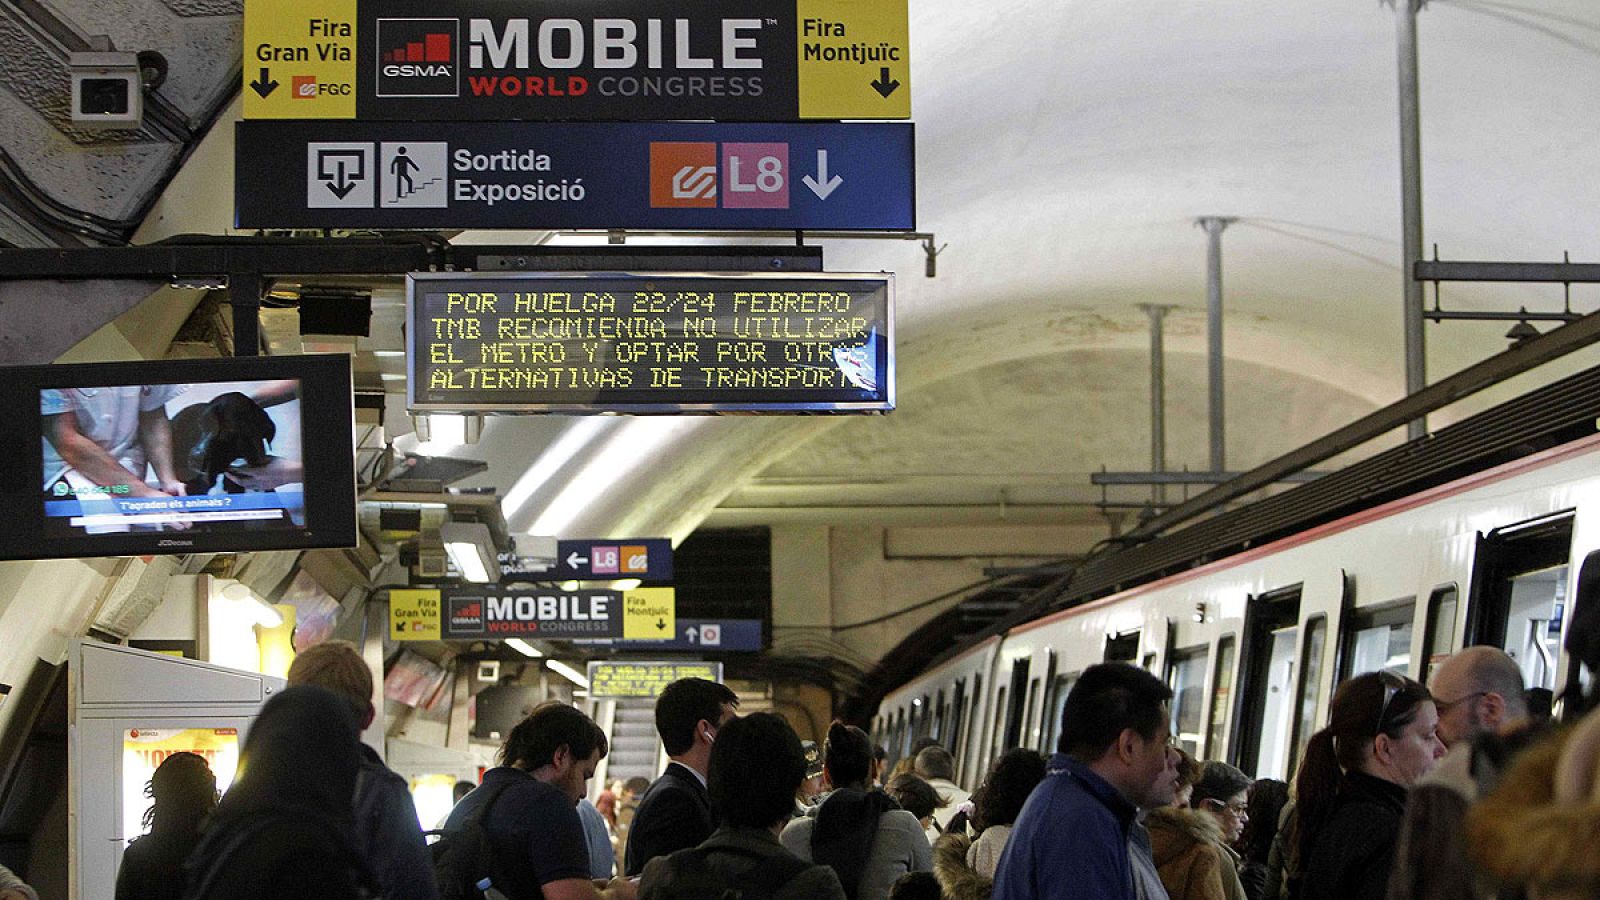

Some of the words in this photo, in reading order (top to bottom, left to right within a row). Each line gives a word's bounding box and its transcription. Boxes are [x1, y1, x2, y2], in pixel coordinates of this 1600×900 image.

[309, 18, 351, 37] Fira
[803, 19, 846, 37] Fira
[256, 43, 309, 62] Gran
[316, 43, 351, 62] Via
[469, 18, 763, 69] MOBILE
[803, 43, 901, 65] Montjuïc
[383, 64, 452, 77] GSMA
[318, 83, 351, 96] FGC
[468, 76, 588, 97] WORLD
[598, 76, 764, 97] CONGRESS
[453, 148, 552, 172] Sortida
[729, 156, 784, 193] L8
[454, 178, 586, 206] Exposició
[447, 292, 498, 314] POR
[514, 292, 616, 314] HUELGA
[632, 292, 716, 314] 22/24
[734, 291, 851, 313] FEBRERO
[431, 317, 481, 340] TMB
[498, 317, 667, 339] RECOMIENDA
[683, 316, 717, 339] NO
[734, 316, 868, 339] UTILIZAR
[430, 343, 464, 364] EL
[480, 342, 566, 364] METRO
[582, 342, 599, 363] Y
[615, 342, 701, 363] OPTAR
[716, 342, 767, 362] POR
[429, 368, 633, 389] ALTERNATIVAS
[650, 367, 682, 388] DE
[700, 367, 868, 388] TRANSPORT
[594, 551, 617, 568] L8
[417, 599, 437, 609] Fira
[487, 596, 609, 621] MOBILE
[627, 596, 646, 606] Fira
[394, 609, 419, 619] Gran
[421, 609, 437, 618] Via
[487, 623, 537, 633] WORLD
[539, 621, 609, 633] CONGRESS
